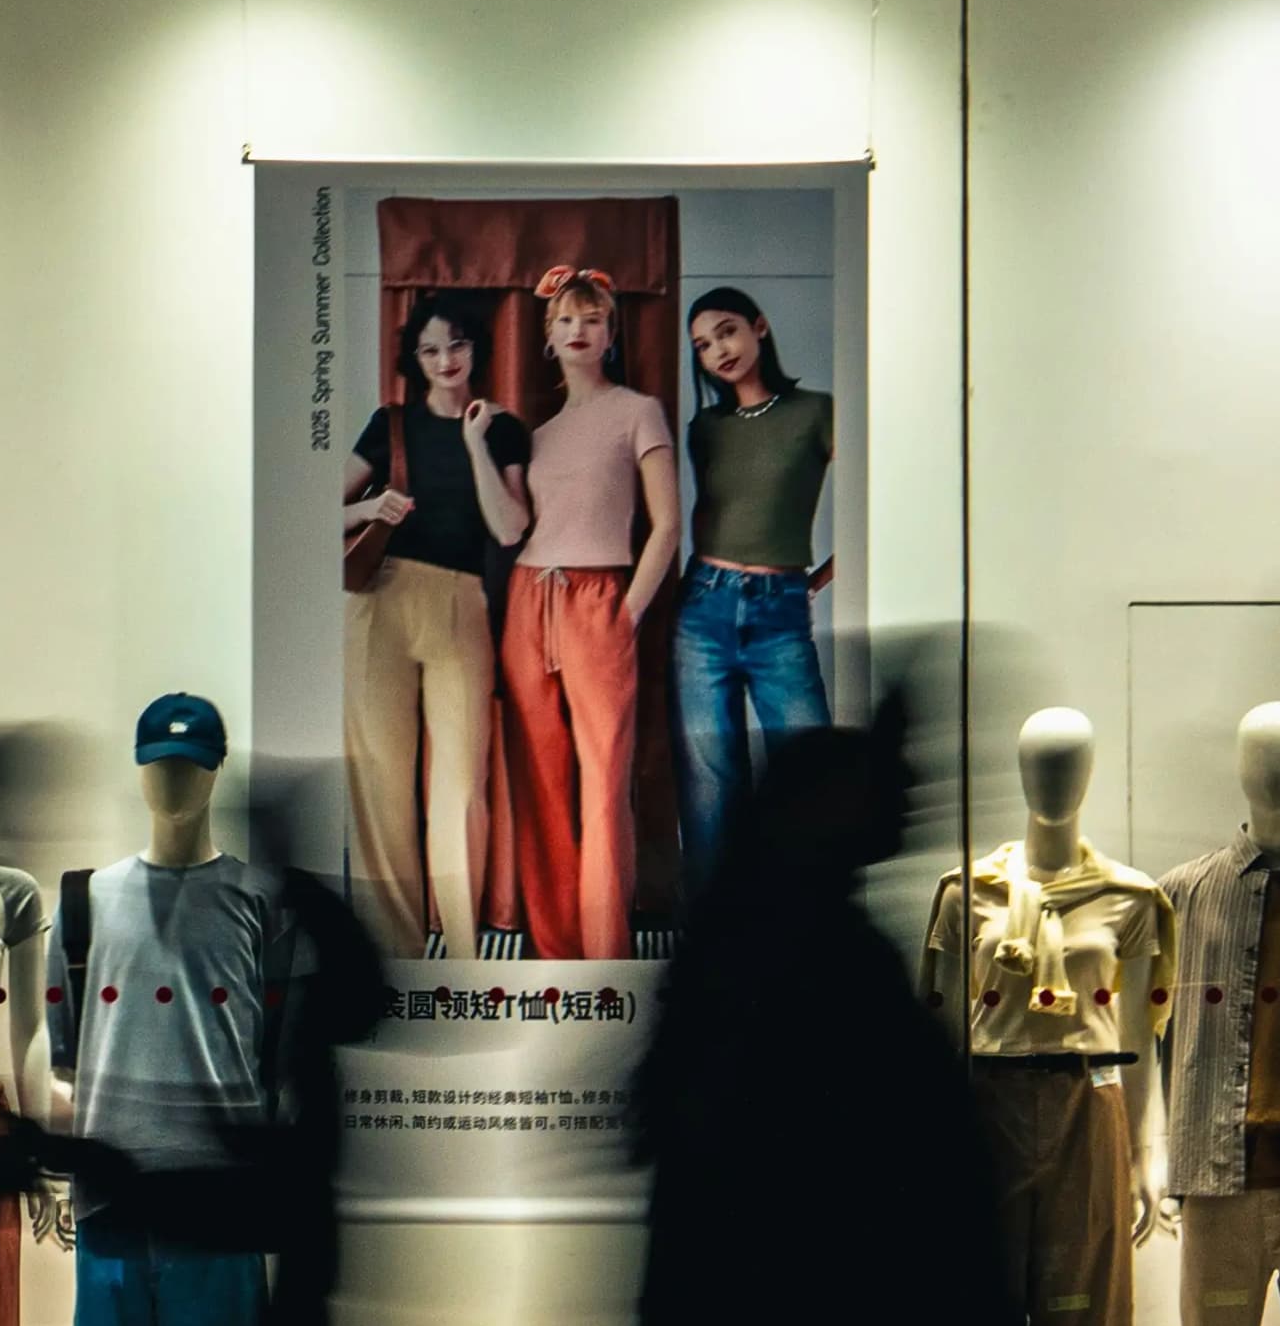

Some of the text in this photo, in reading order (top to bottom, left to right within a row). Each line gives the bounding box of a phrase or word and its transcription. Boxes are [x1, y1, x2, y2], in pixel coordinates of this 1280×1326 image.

[311, 186, 334, 452] 2025 Spring Summer Collection
